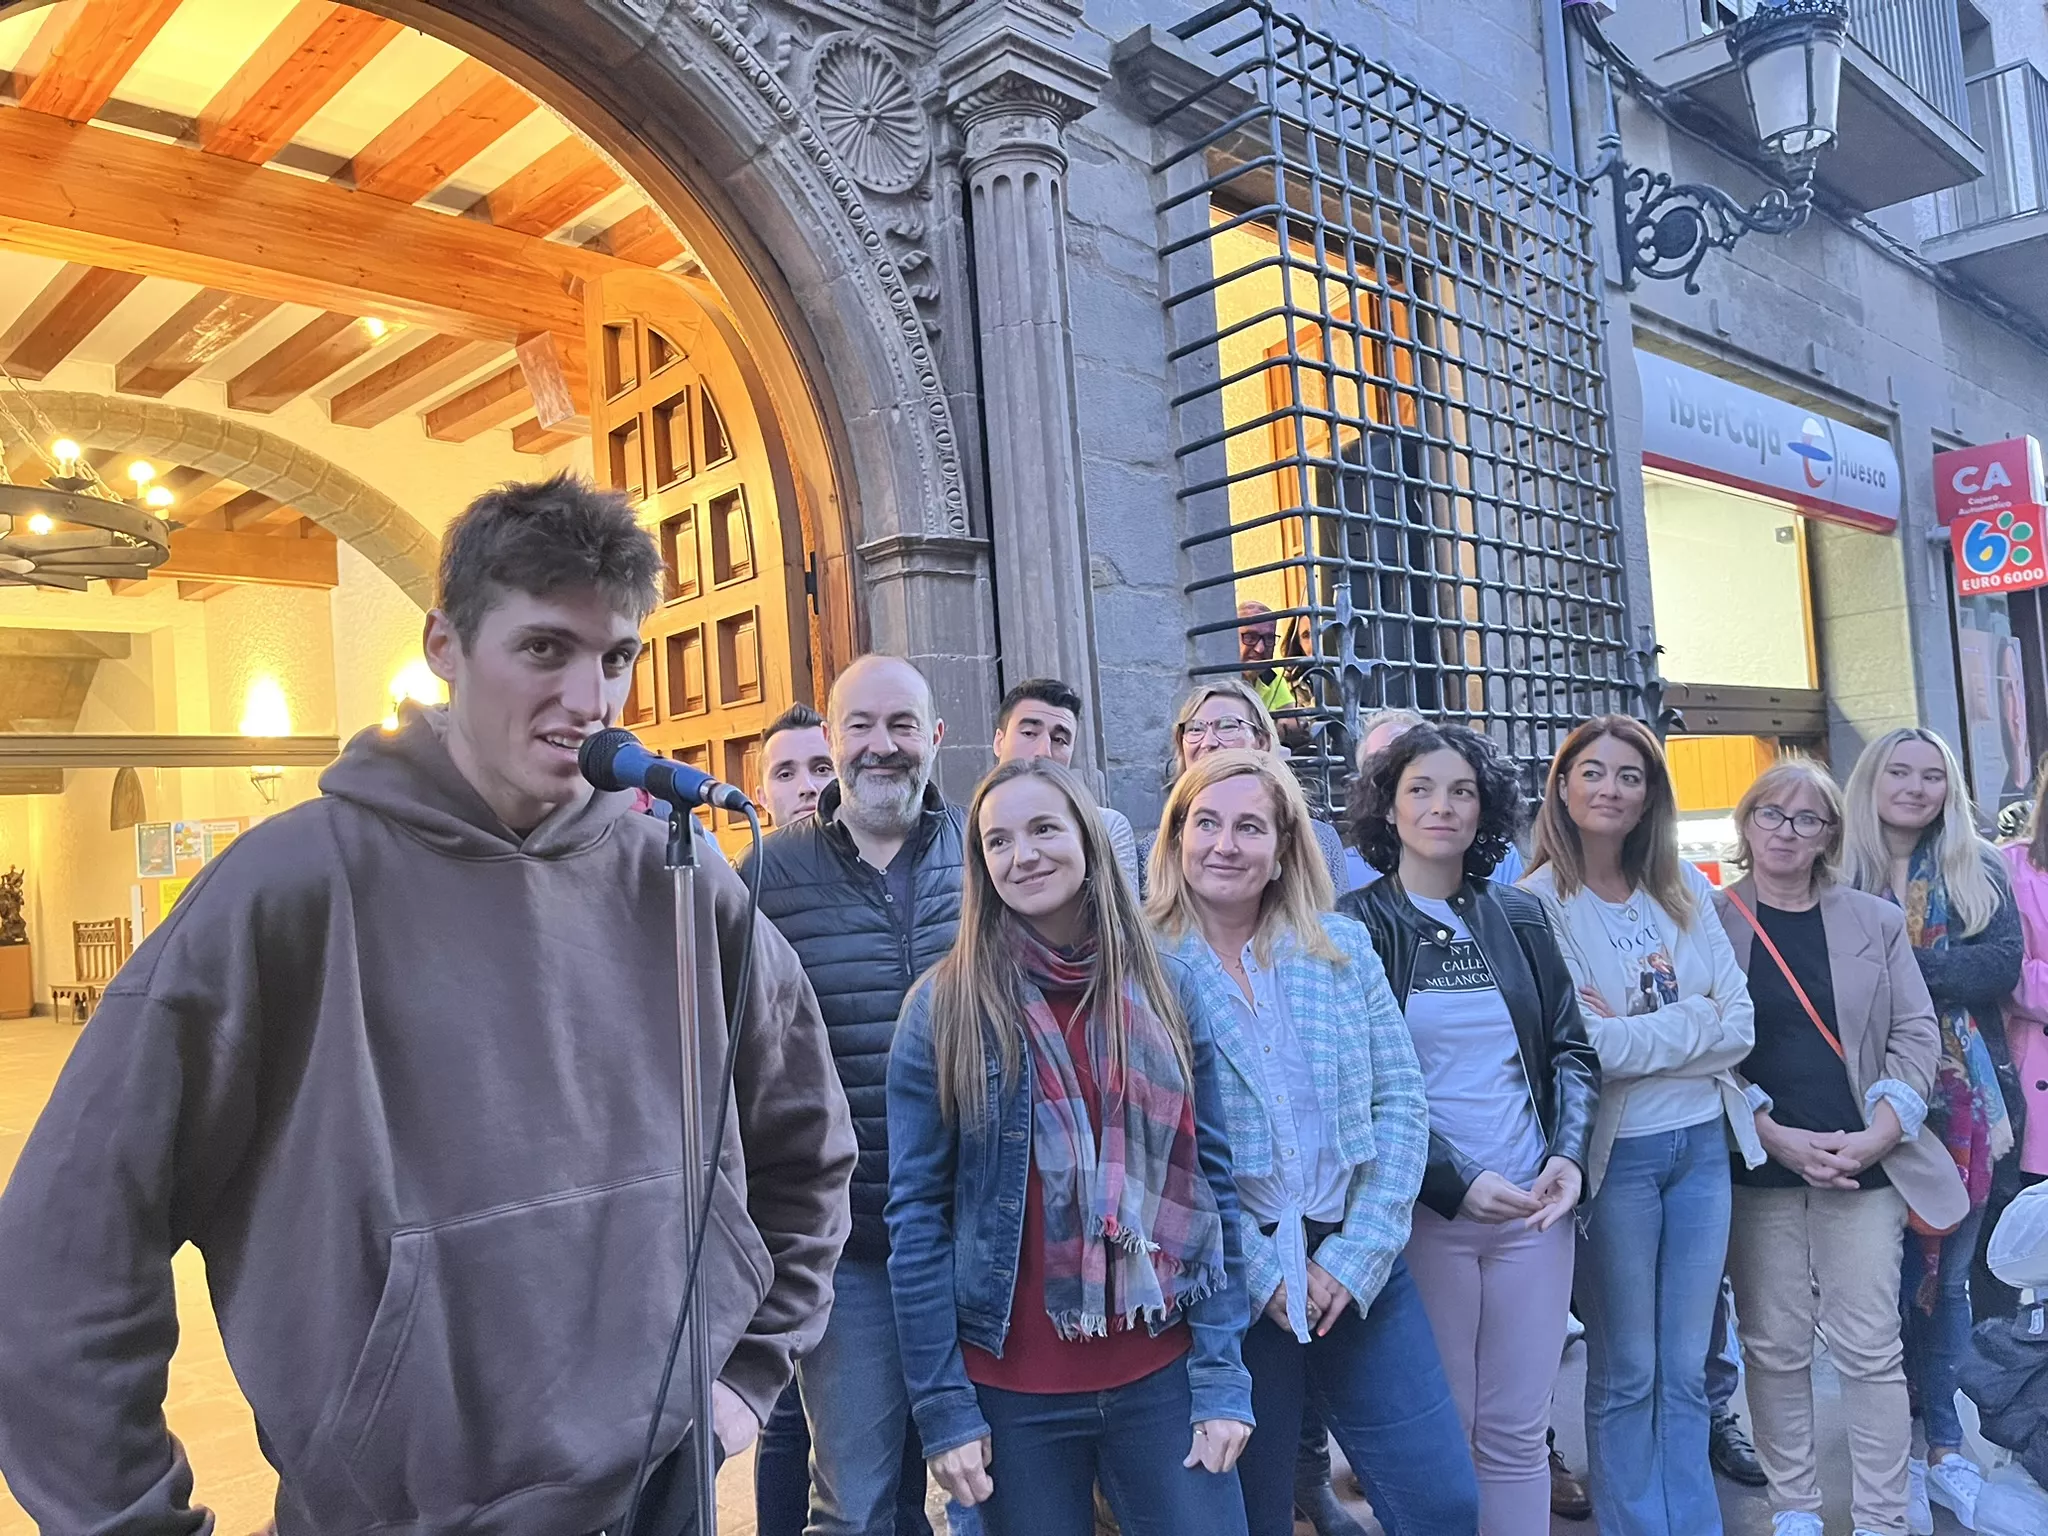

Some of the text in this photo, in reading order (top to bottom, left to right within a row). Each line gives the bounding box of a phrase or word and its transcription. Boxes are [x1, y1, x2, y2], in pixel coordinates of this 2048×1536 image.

[1839, 454, 1887, 489] Huesca
[1952, 461, 2012, 495] CA
[1962, 567, 2044, 591] EURO 6000
[1442, 959, 1484, 973] CALLE
